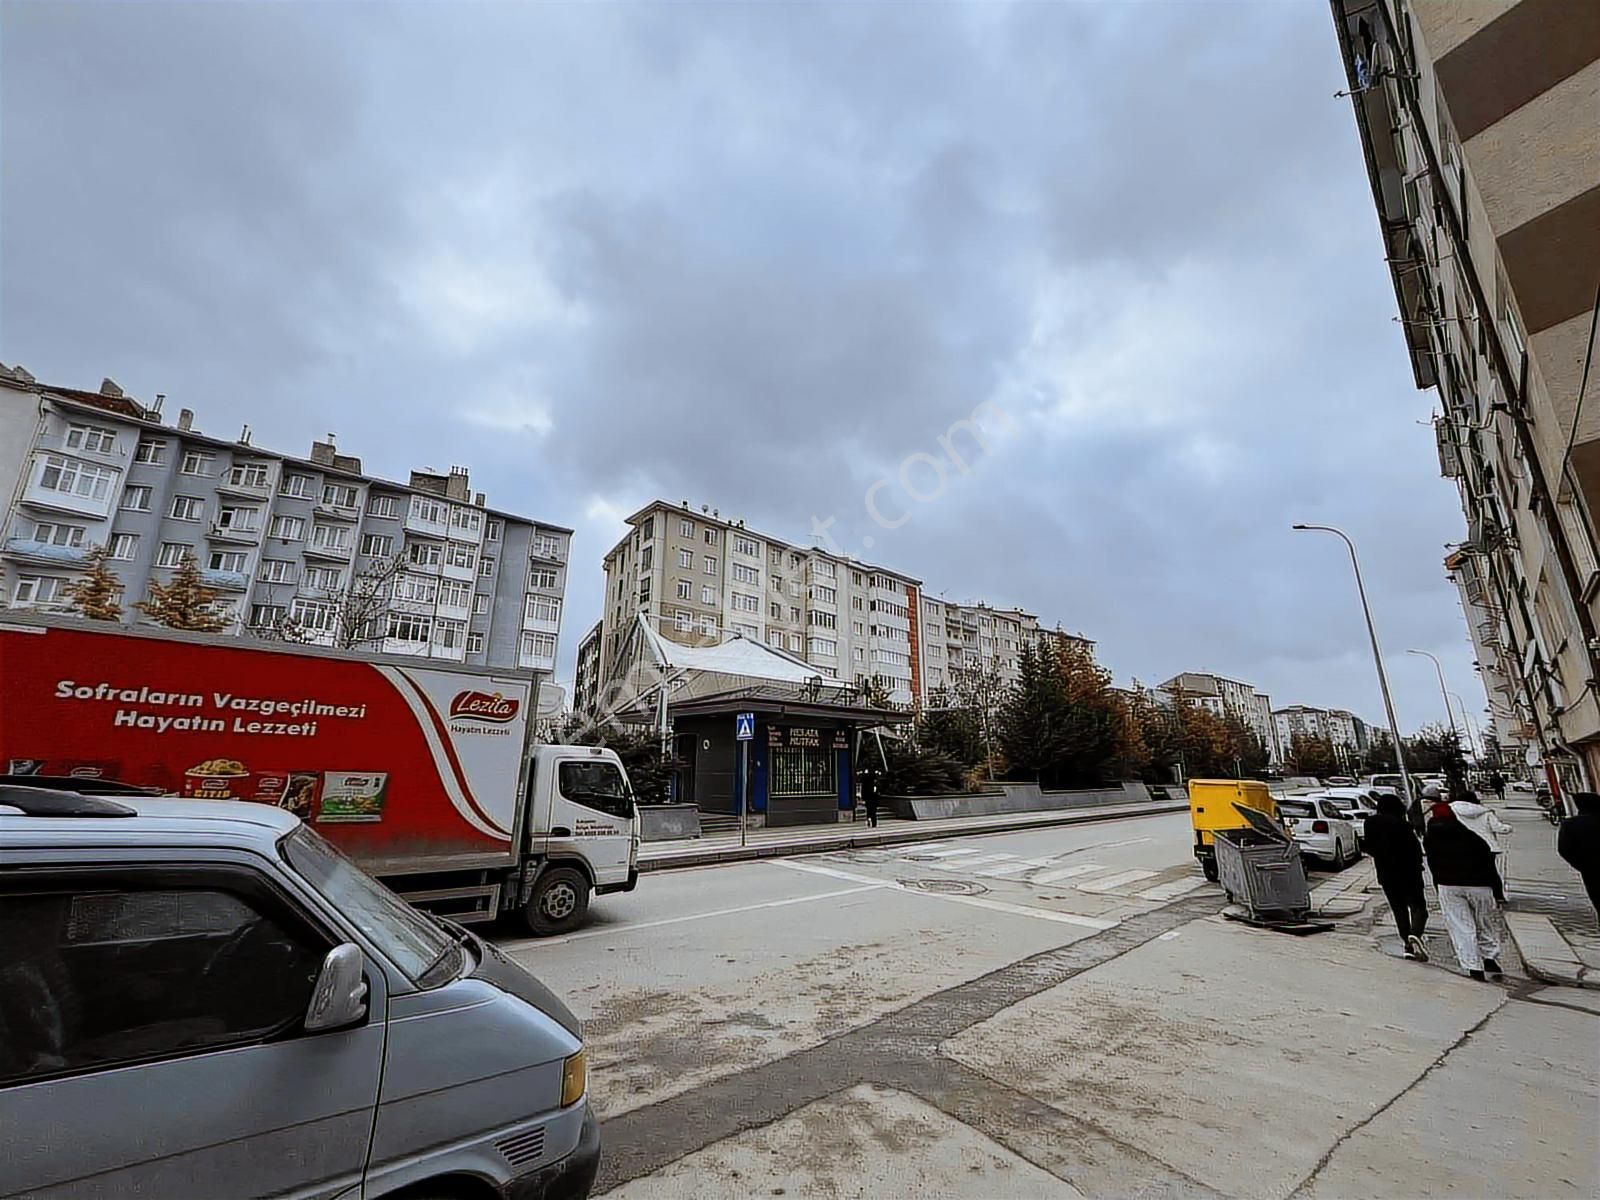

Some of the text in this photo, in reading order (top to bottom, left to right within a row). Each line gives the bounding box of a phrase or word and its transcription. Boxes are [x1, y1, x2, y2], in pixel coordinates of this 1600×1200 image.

[55, 680, 366, 718] Sofraların Vazgeçilmezi
[457, 690, 512, 714] Lezita
[114, 709, 317, 736] Hayatın Lezzeti
